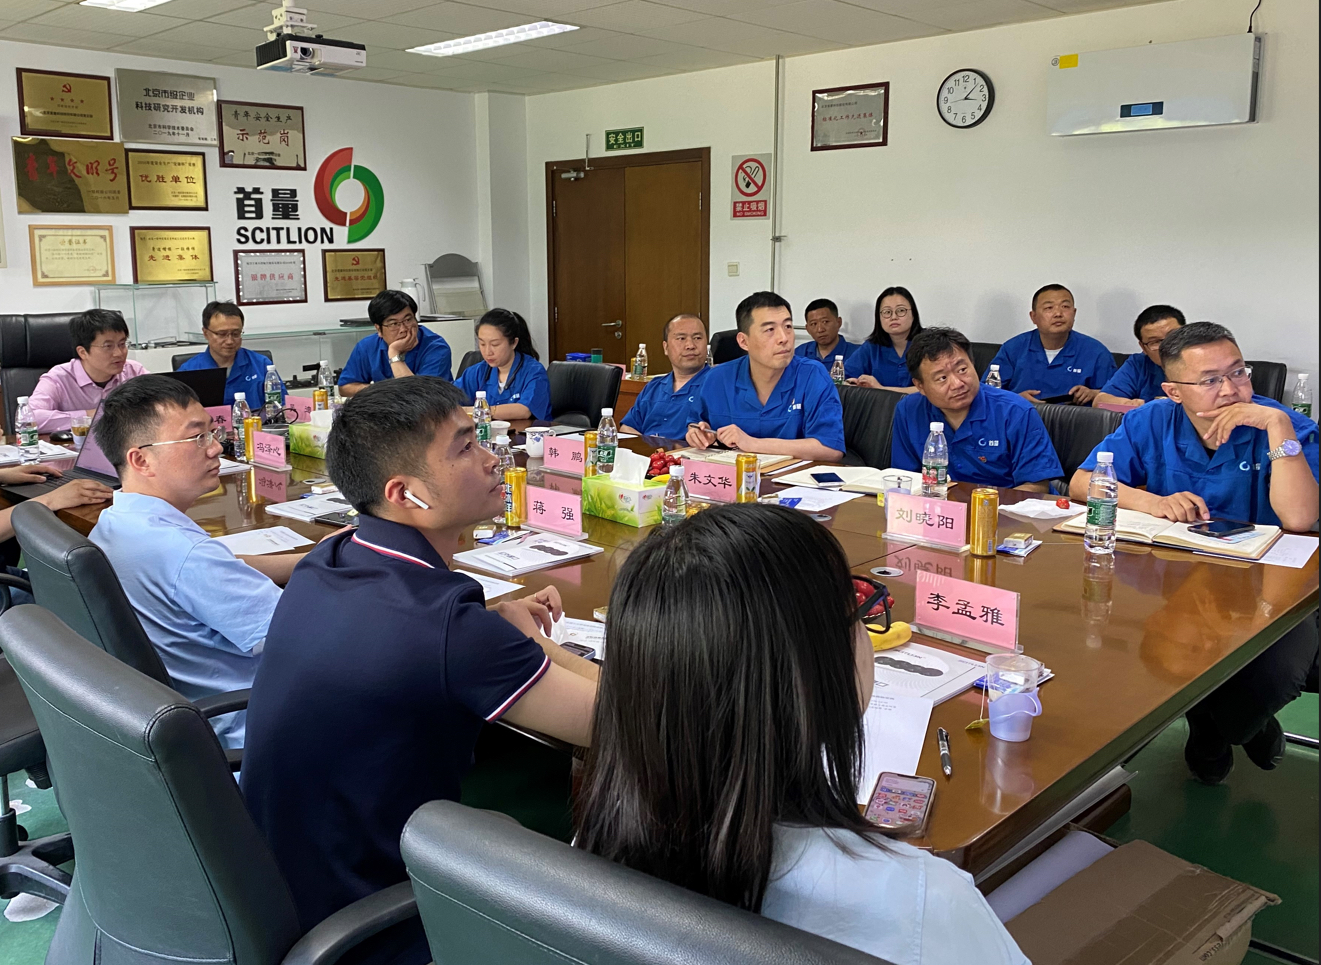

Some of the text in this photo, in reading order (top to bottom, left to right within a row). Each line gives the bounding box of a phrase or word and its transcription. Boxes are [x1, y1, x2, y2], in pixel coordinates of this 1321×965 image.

[954, 79, 960, 87] 11
[962, 74, 970, 83] 12
[973, 77, 977, 85] 1
[143, 87, 195, 101] 北京市级企业
[947, 86, 954, 95] 10
[979, 84, 985, 93] 2
[943, 96, 949, 105] 9
[981, 94, 987, 103] 3
[135, 101, 204, 116] 科技研究开发机构
[947, 105, 952, 114] 8
[977, 104, 982, 112] 4
[232, 109, 293, 124] 青年安全生产
[953, 112, 958, 121] 7
[961, 115, 967, 124] 6
[970, 112, 976, 120] 5
[236, 128, 289, 147] 示范岗
[608, 132, 641, 145] 安全出口
[25, 153, 119, 183] 青年文明号
[139, 174, 197, 185] 优胜单位
[233, 186, 301, 221] 首量
[735, 201, 765, 212] 禁止吸烟
[235, 226, 335, 245] SCITLION
[147, 254, 200, 262] 先进集体
[250, 272, 294, 282] 银牌供应商
[256, 442, 282, 457] 冯泽心
[548, 447, 583, 463] 韩鹏
[688, 472, 733, 489] 朱文华
[533, 500, 575, 521] 蒋强
[895, 507, 955, 530] 刘晓阳
[926, 592, 1005, 627] 李孟雅
